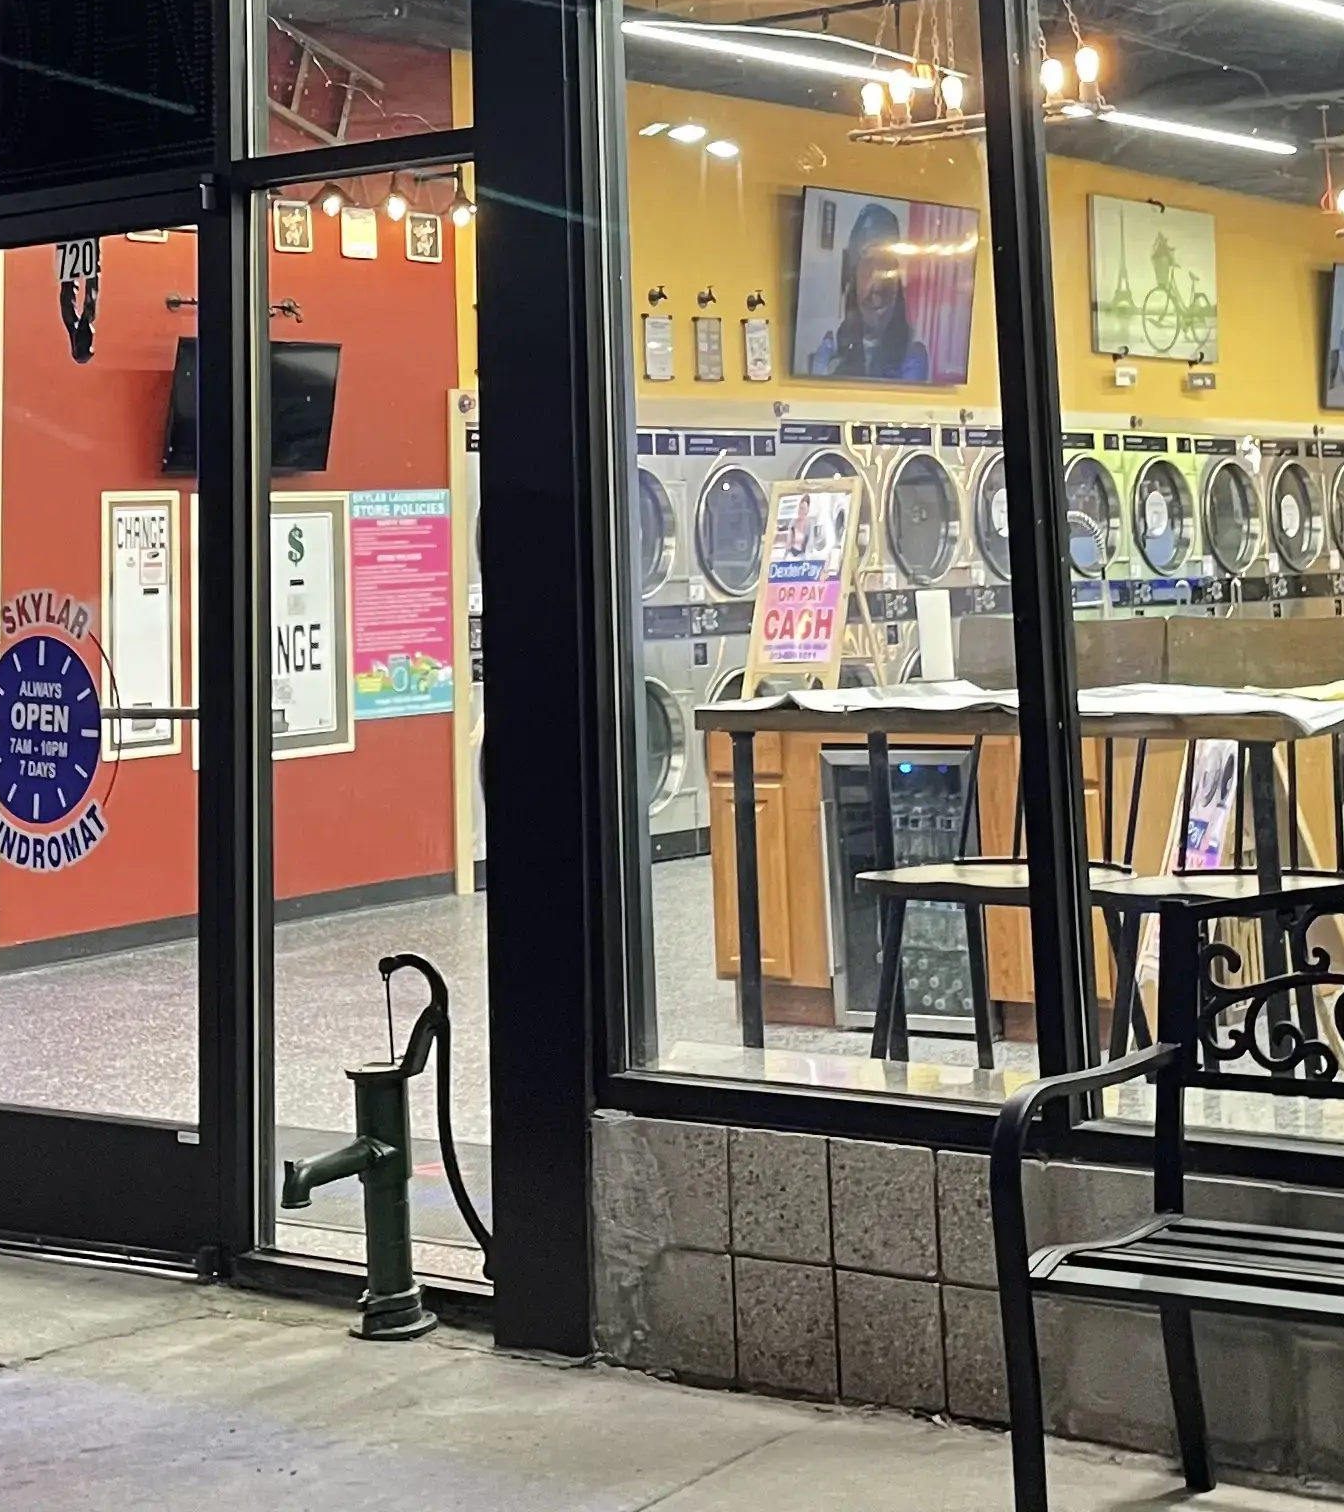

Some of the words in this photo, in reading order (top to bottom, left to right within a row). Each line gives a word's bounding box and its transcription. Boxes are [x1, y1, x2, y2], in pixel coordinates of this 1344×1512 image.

[56, 241, 93, 279] 720
[353, 503, 390, 517] STORE
[393, 502, 446, 516] POLICIES
[117, 516, 165, 549] CHANGE
[770, 561, 823, 581] DexterPay
[778, 586, 795, 602] OR
[799, 585, 825, 602] PAY
[2, 591, 89, 639] SKYLAR
[764, 608, 833, 641] CASH
[276, 622, 322, 676] NGE
[19, 681, 63, 699] ALWAYS
[10, 702, 70, 734] OPEN
[10, 738, 32, 756] 7AM
[40, 740, 68, 758] 10PM
[19, 760, 26, 777] 7
[27, 760, 57, 779] DAYS
